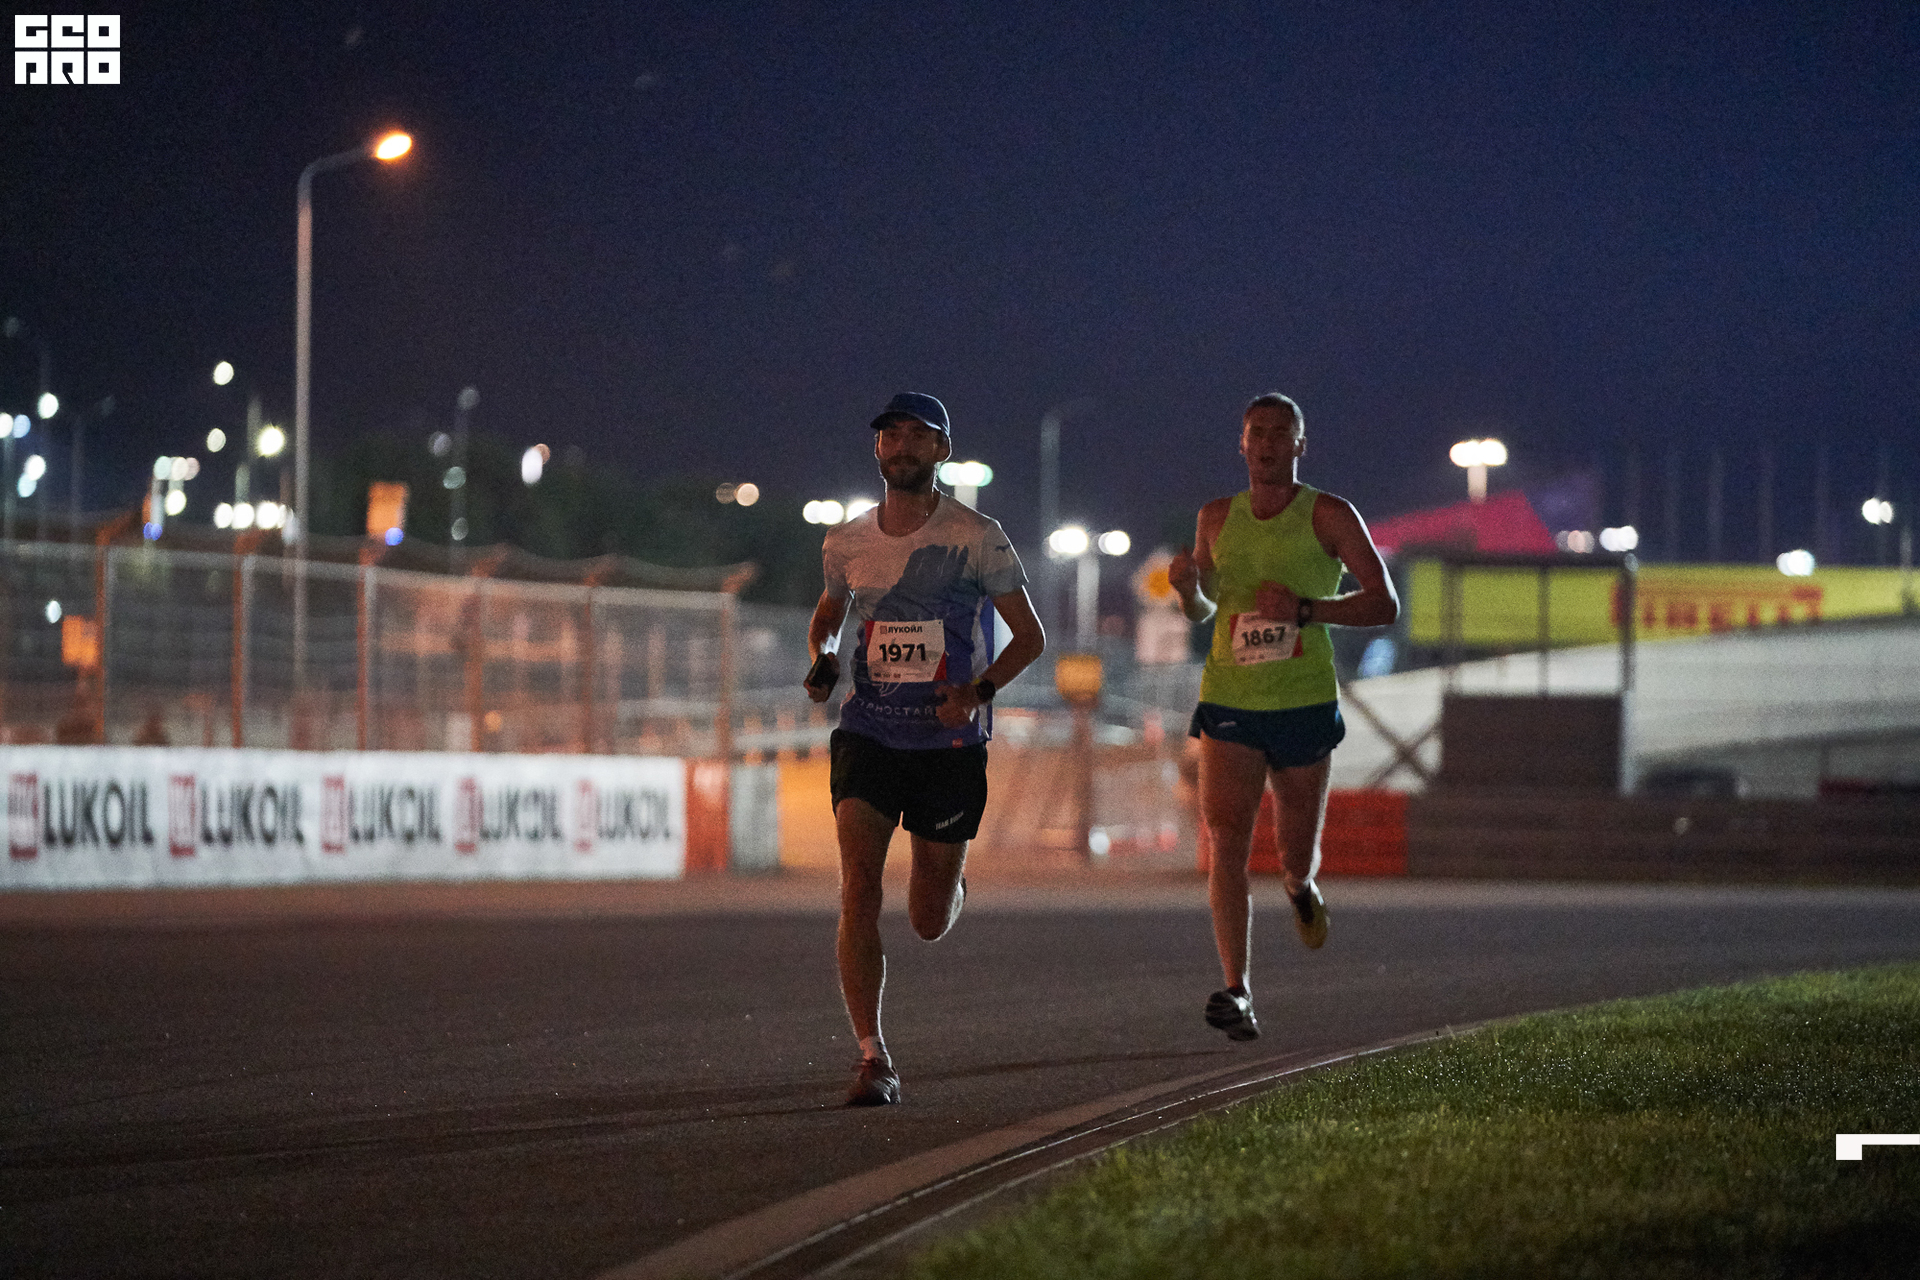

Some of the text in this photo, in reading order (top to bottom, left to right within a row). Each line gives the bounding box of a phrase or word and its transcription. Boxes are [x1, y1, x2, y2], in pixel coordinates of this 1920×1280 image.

[888, 625, 923, 634] ЛУКОЙЛ
[1242, 625, 1286, 646] 1867
[879, 643, 926, 662] 1971
[44, 777, 154, 849] LUKOIL
[200, 780, 305, 848] LUKOIL
[348, 782, 441, 844] LUKOIL
